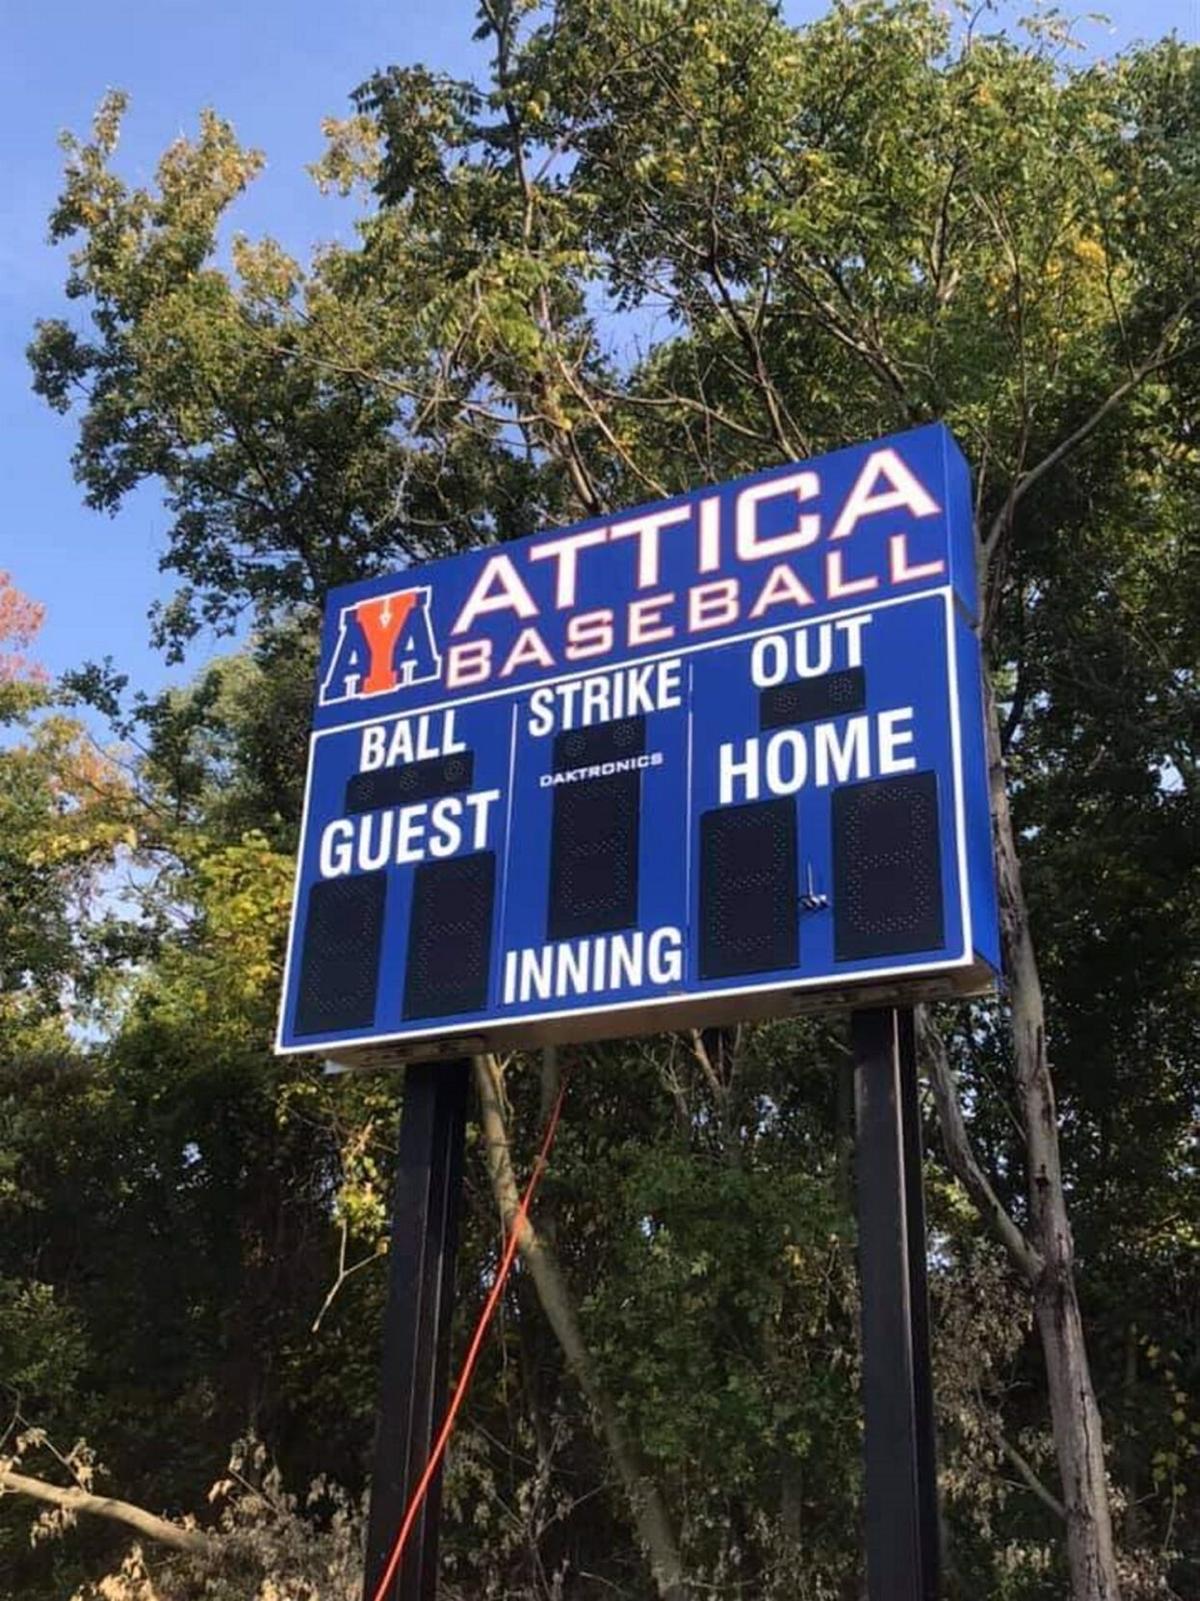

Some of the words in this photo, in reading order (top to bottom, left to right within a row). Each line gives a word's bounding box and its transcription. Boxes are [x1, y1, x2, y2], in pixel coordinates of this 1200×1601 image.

[451, 449, 941, 634] ATTICA
[445, 534, 945, 688] BASEBALL
[751, 615, 872, 688] OUT
[528, 658, 682, 737] STRIKE
[360, 711, 466, 772] BALL
[539, 752, 664, 788] DAKTRONICS
[719, 708, 916, 804] HOME
[320, 790, 499, 878] GUEST
[504, 927, 683, 1004] INNING
